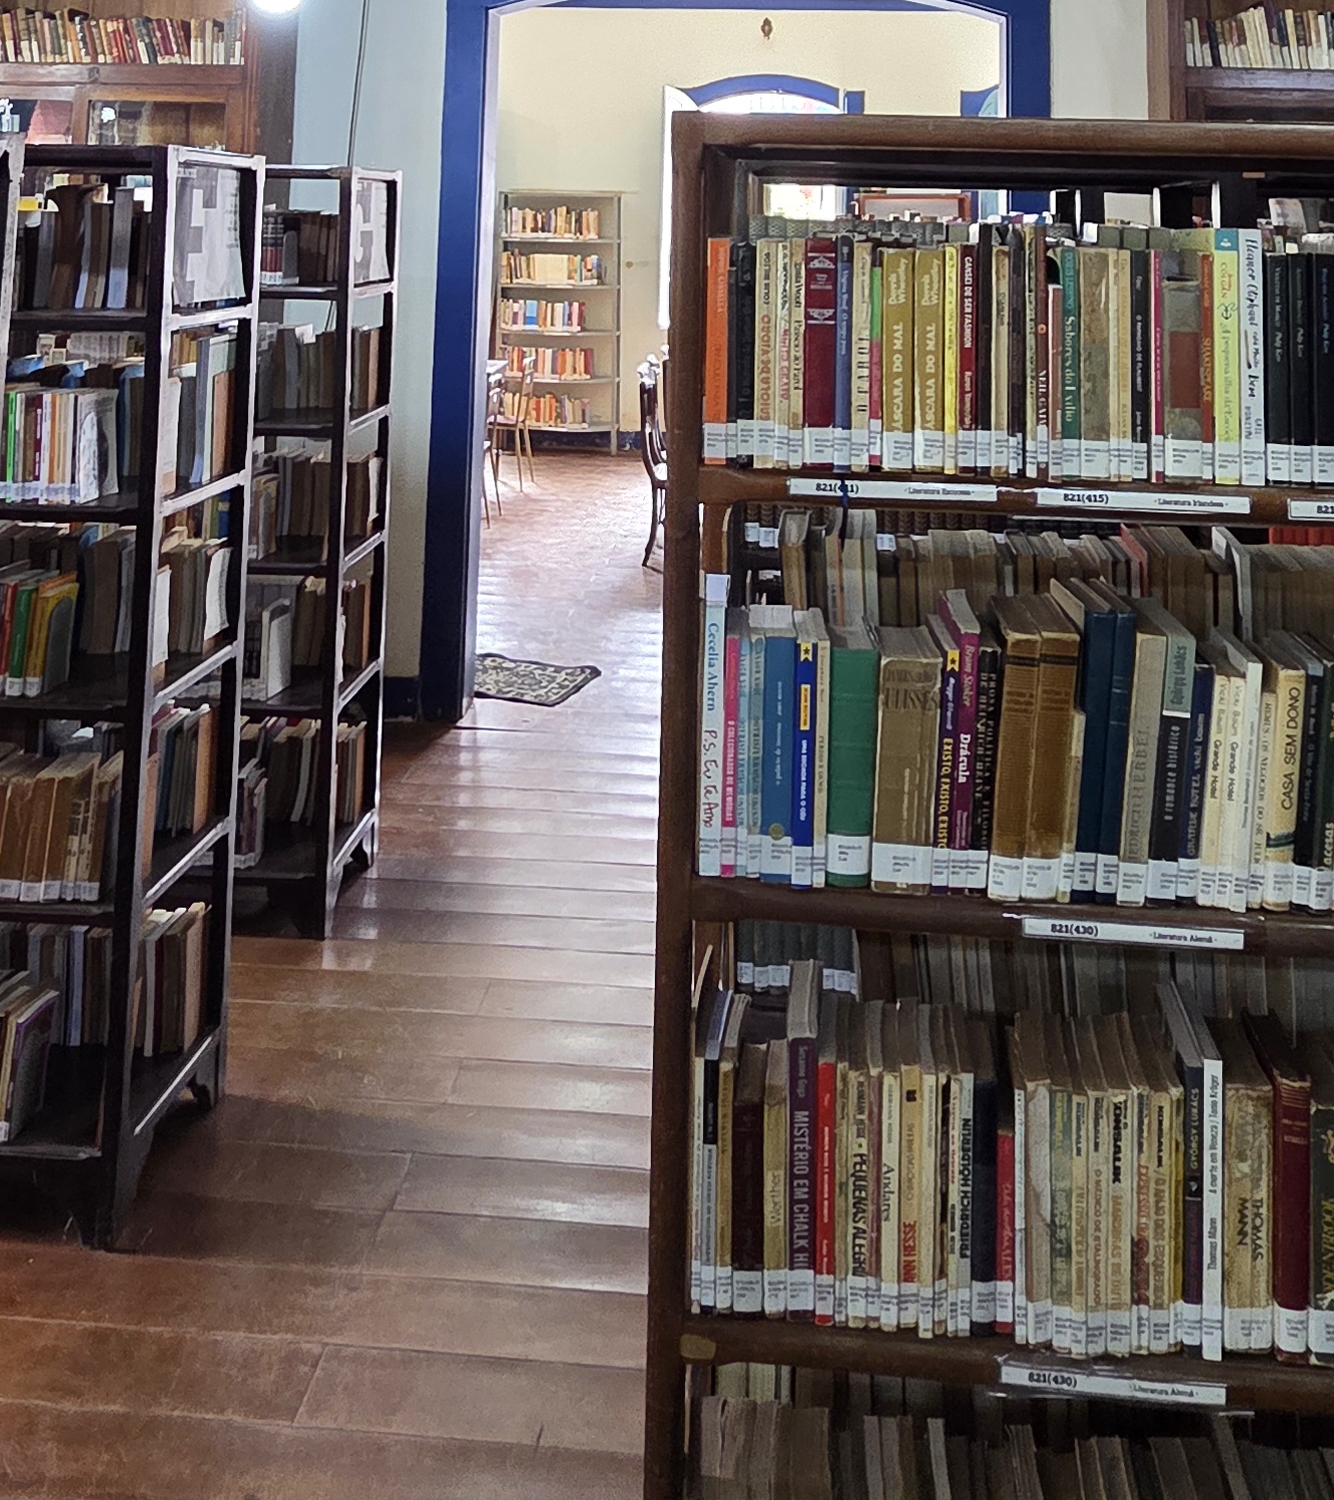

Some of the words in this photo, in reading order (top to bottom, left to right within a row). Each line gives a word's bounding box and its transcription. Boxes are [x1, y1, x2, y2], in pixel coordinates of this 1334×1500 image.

[964, 256, 972, 285] CANSEI
[1220, 262, 1228, 298] COLGAN
[964, 286, 972, 297] DE
[964, 298, 972, 313] SER
[893, 322, 903, 350] MAL
[925, 323, 935, 350] MAL
[964, 314, 972, 348] FASHION
[1064, 316, 1076, 367] Sabores
[893, 354, 903, 372] DO
[925, 354, 935, 372] DO
[1065, 369, 1075, 384] do
[1202, 337, 1212, 403] SHAKESPEARE
[892, 378, 903, 432] ÁSCARA
[925, 379, 936, 429] ÁSCARA
[816, 482, 860, 495] 821(11)
[1064, 492, 1110, 505] 821(415)
[705, 623, 720, 669] Cecelia
[962, 644, 975, 671] Bram
[706, 672, 719, 712] Ahern
[962, 674, 974, 707] Stoker
[980, 672, 989, 690] DE
[988, 673, 997, 714] PROSA
[976, 695, 988, 756] HEINRICH
[1285, 687, 1301, 730] DONO
[703, 729, 718, 756] P.S.
[939, 738, 953, 776] EXISTO,
[957, 733, 972, 783] Drácula
[982, 720, 995, 778] POLÍTICA
[1165, 724, 1181, 768] histórico
[1212, 739, 1222, 771] Grande
[1227, 741, 1238, 774] Grande
[1284, 734, 1298, 765] SEM
[938, 778, 952, 814] EXISTO,
[975, 762, 985, 799] HEINE
[1165, 771, 1178, 812] romance
[1209, 775, 1220, 800] Hotel
[1226, 777, 1236, 802] Hotel
[1280, 771, 1296, 811] CASA
[702, 803, 717, 829] Amo
[937, 816, 949, 850] EXISTO
[1051, 923, 1099, 937] 821(430)
[793, 1111, 812, 1174] MISTÉRIO
[958, 1117, 972, 1188] HÖLDERLIN
[793, 1179, 810, 1200] EM
[849, 1153, 868, 1225] PEQUENAS
[881, 1162, 896, 1223] Andares
[793, 1203, 811, 1249] CHALK
[903, 1220, 916, 1257] HESSE
[959, 1190, 971, 1259] FRIEDRICH
[1208, 1217, 1218, 1239] Mann
[1237, 1197, 1249, 1247] MANN
[1252, 1198, 1264, 1262] THOMAS
[852, 1226, 868, 1277] ALEGRI
[1207, 1241, 1218, 1270] Thomas
[1028, 1371, 1078, 1388] 821(430)
